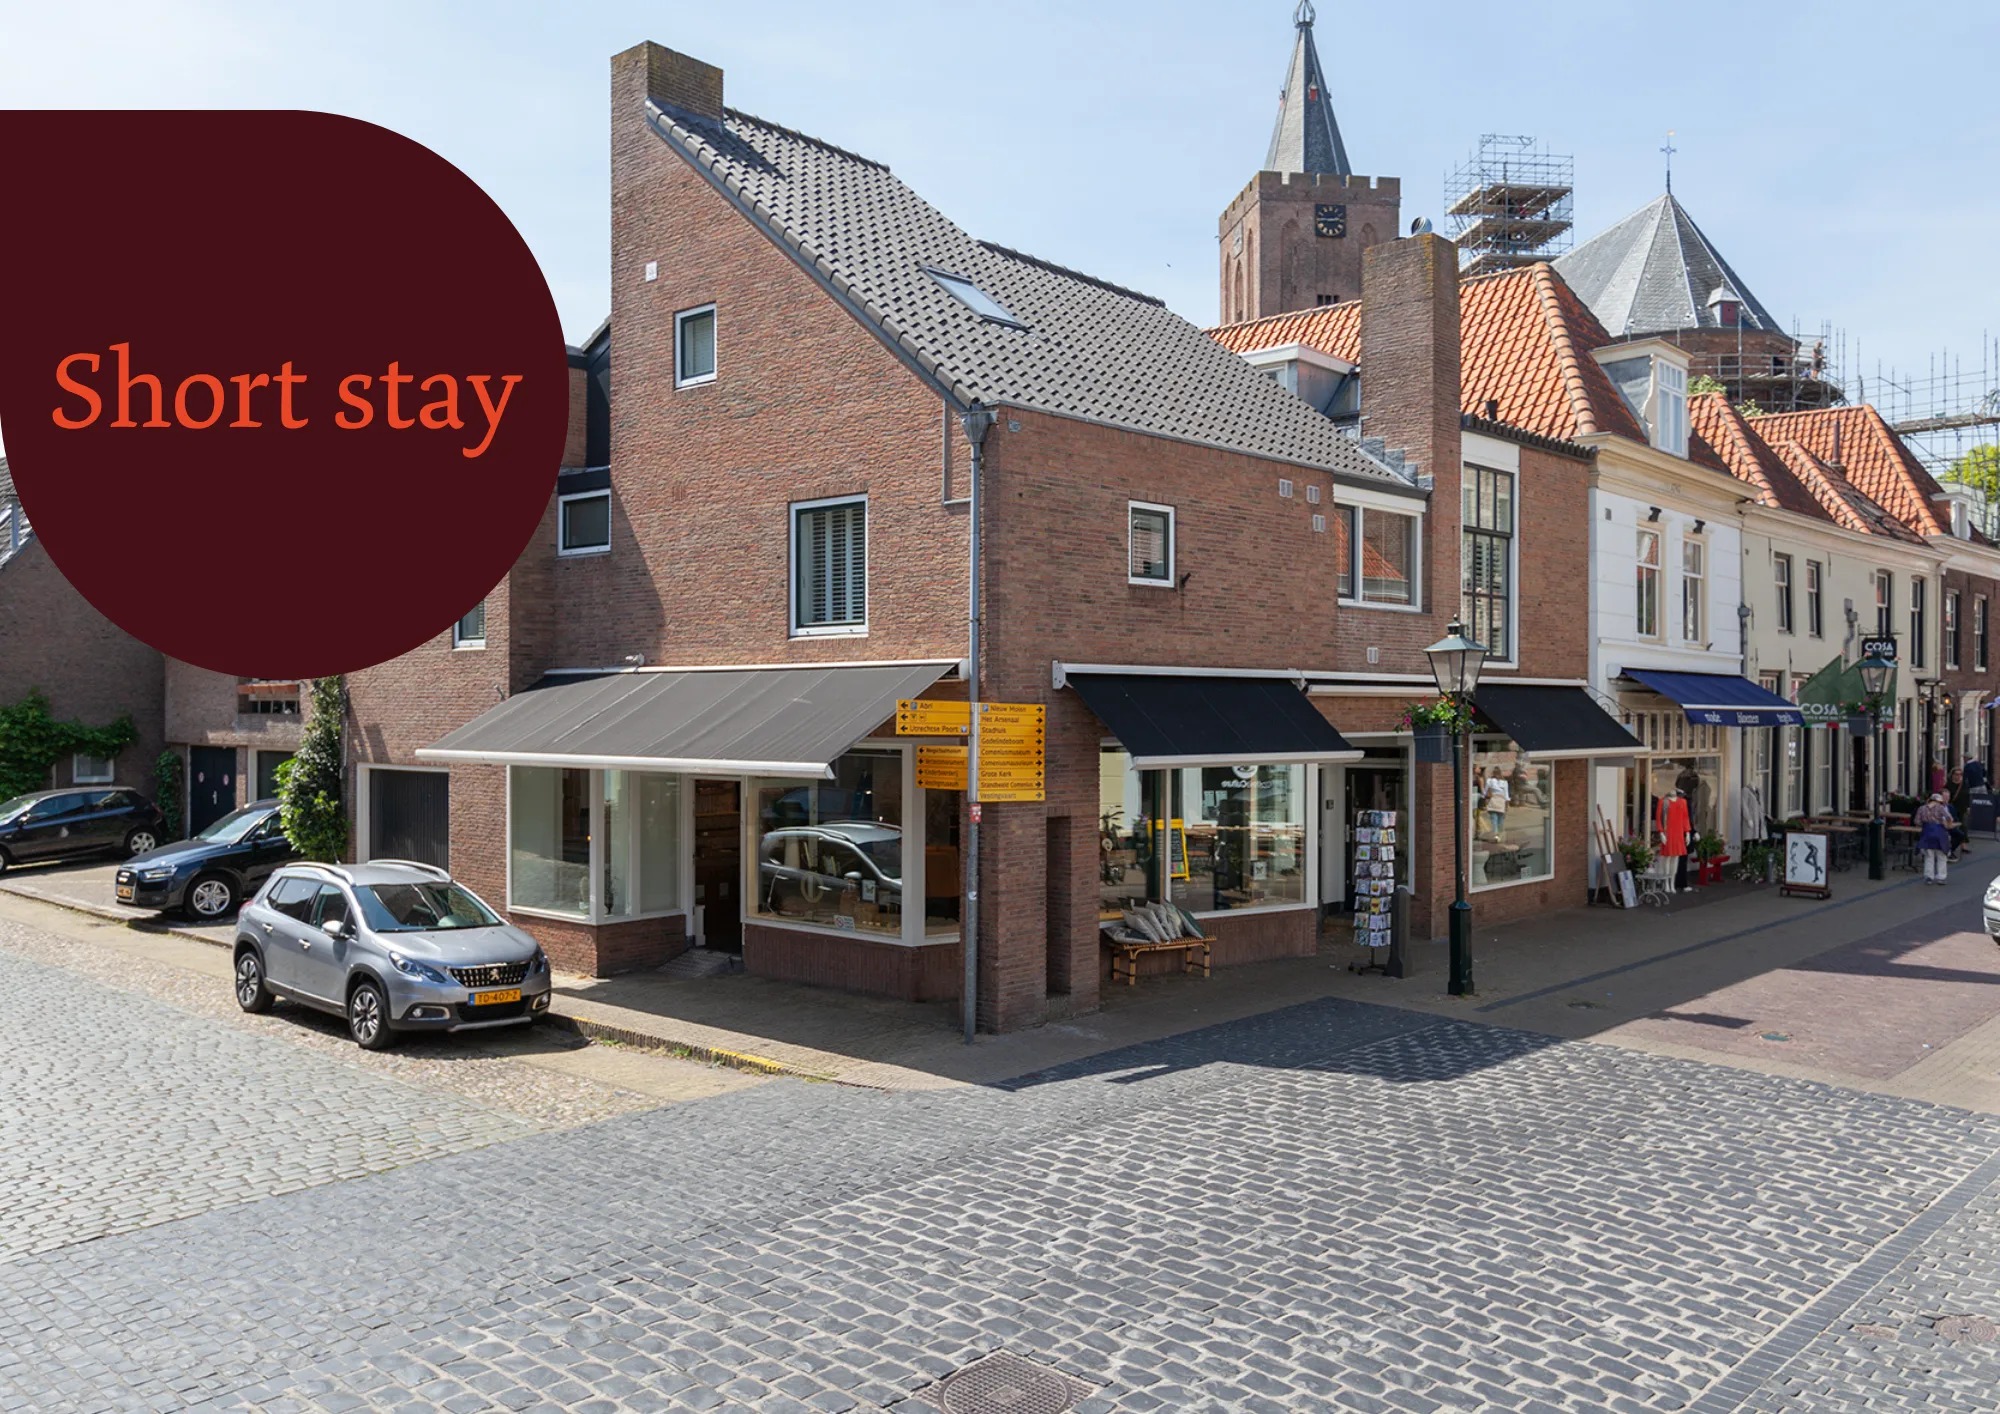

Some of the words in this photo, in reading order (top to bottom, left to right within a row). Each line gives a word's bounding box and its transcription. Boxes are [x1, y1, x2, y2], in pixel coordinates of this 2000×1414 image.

[1864, 642, 1894, 651] COSA
[1800, 703, 1838, 715] COSA
[477, 990, 518, 1003] TD-407-Z
